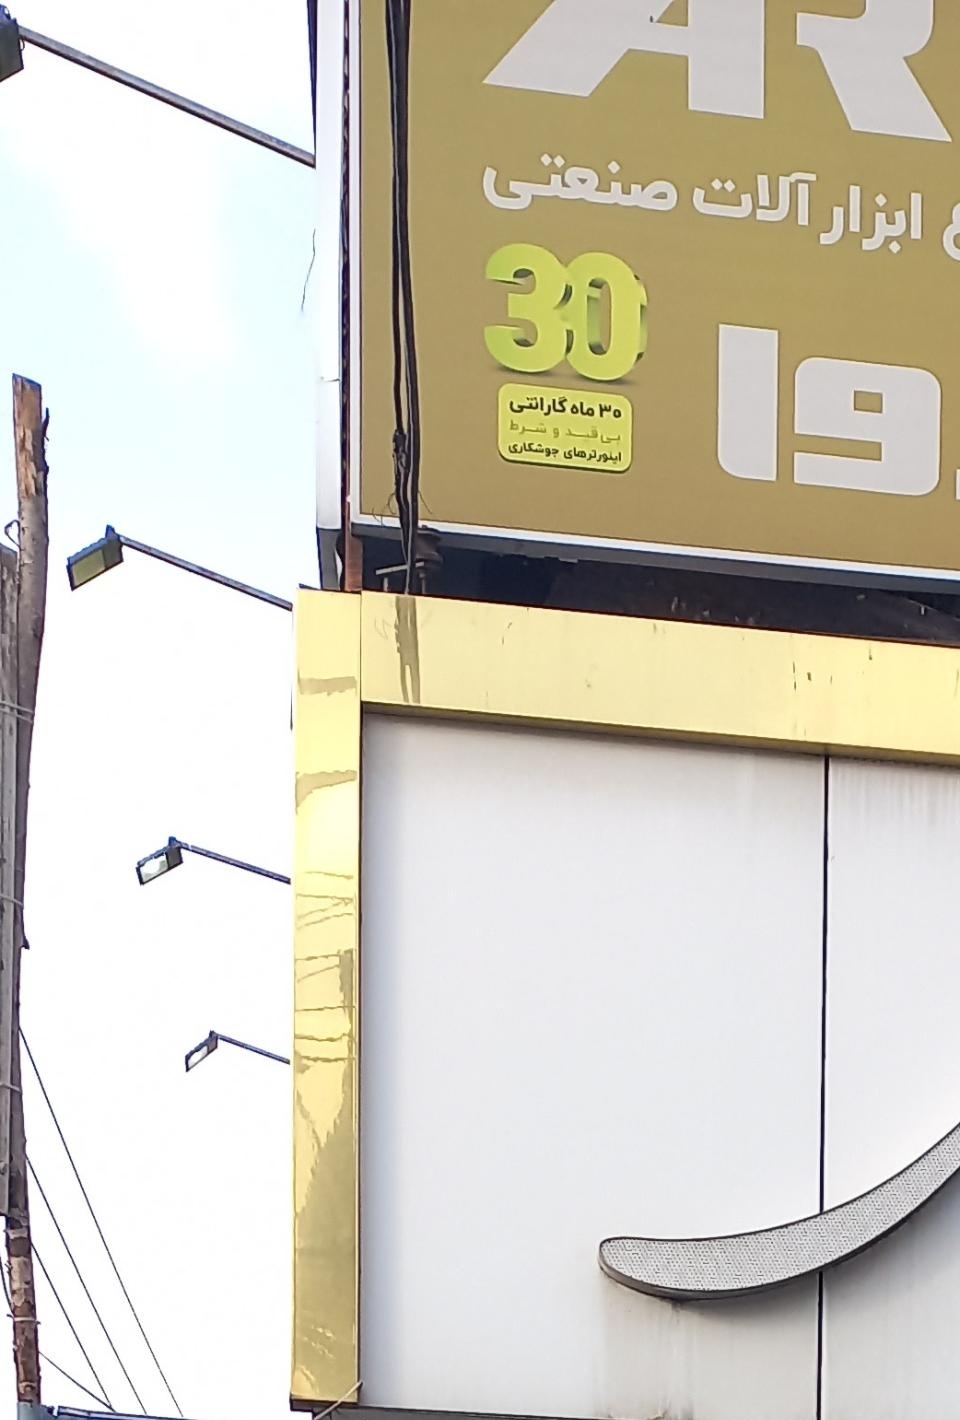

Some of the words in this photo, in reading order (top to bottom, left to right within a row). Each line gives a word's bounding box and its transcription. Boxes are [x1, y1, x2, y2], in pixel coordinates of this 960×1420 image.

[482, 152, 679, 212] صنعتی
[692, 172, 817, 226] آلات
[819, 184, 923, 255] ابزار
[484, 242, 648, 382] 30
[509, 396, 568, 416] گارانتی
[570, 401, 595, 417] ماه
[508, 441, 560, 458] جوشکاری
